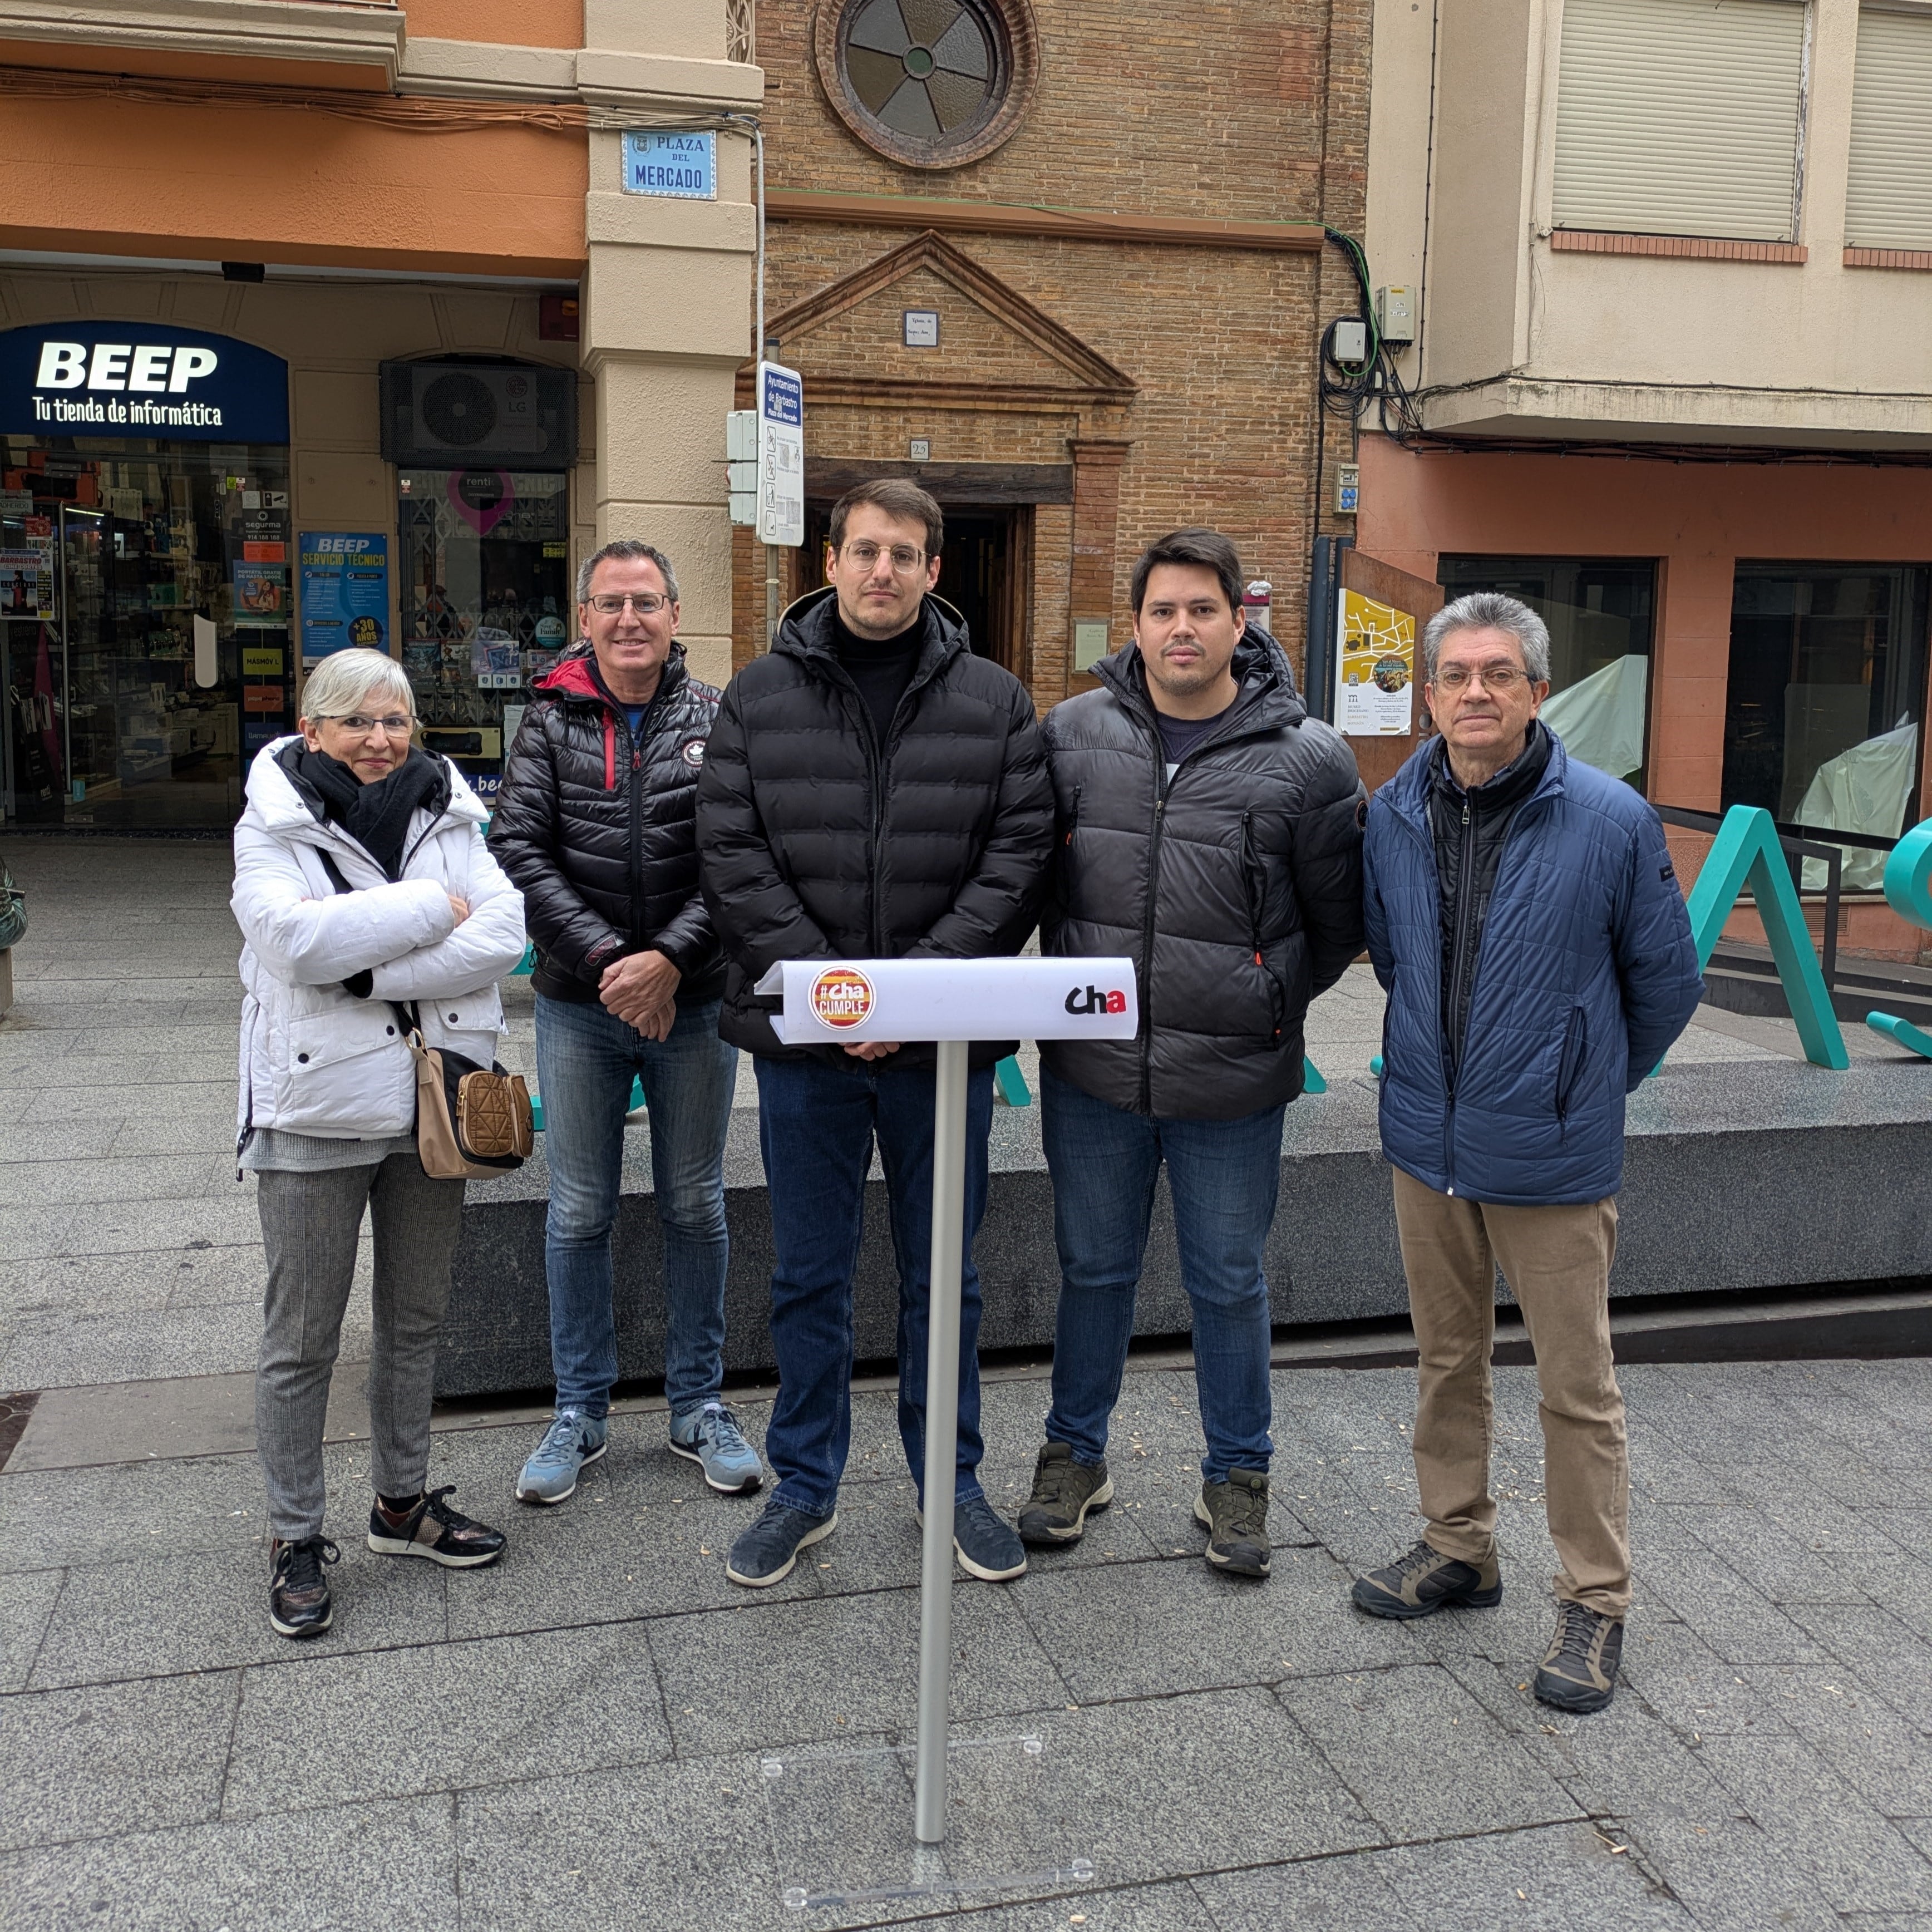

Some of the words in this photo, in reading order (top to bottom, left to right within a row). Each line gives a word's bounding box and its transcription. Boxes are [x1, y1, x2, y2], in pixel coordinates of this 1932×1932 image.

[657, 136, 704, 151] PLAZA
[635, 165, 702, 189] MERCADO
[36, 342, 218, 393] BEEP
[768, 374, 799, 394] Ayuntamiento
[768, 391, 775, 402] de
[776, 393, 797, 409] Barbastro
[32, 396, 51, 421] Tu
[53, 397, 105, 423] tienda
[108, 398, 127, 424] de
[130, 400, 223, 427] informática
[768, 408, 777, 417] Plaza
[783, 412, 797, 422] Mercado
[318, 538, 369, 553] BEEP
[302, 553, 344, 566] SERVICIO
[347, 551, 385, 566] TÉCNICO
[353, 618, 374, 633] +30
[819, 1000, 865, 1016] CUMPLE
[1064, 985, 1127, 1015] cha
